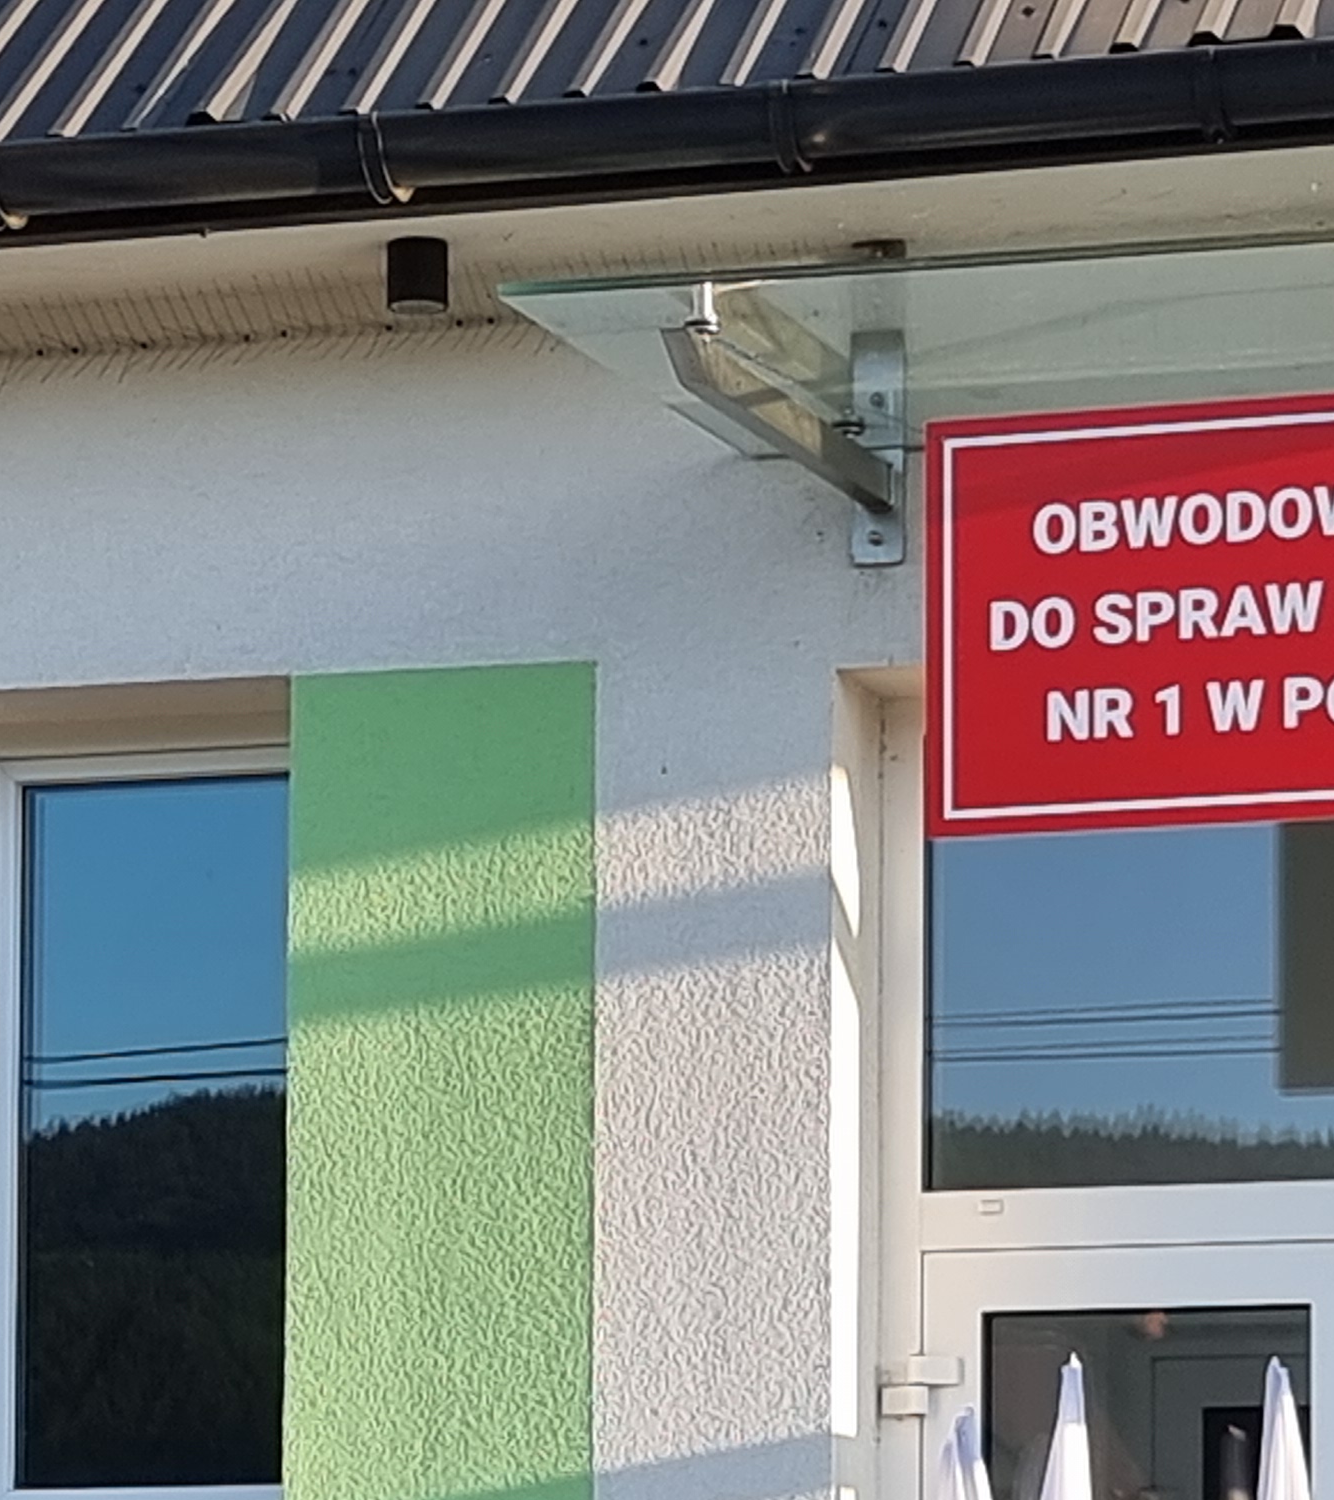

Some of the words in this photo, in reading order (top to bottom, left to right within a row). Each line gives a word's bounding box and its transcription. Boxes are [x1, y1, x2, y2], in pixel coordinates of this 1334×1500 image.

[990, 596, 1075, 652] DO
[1093, 580, 1324, 645] SPRAW
[1047, 688, 1133, 741] NR
[1155, 684, 1180, 735] 1
[1206, 679, 1264, 732] W
